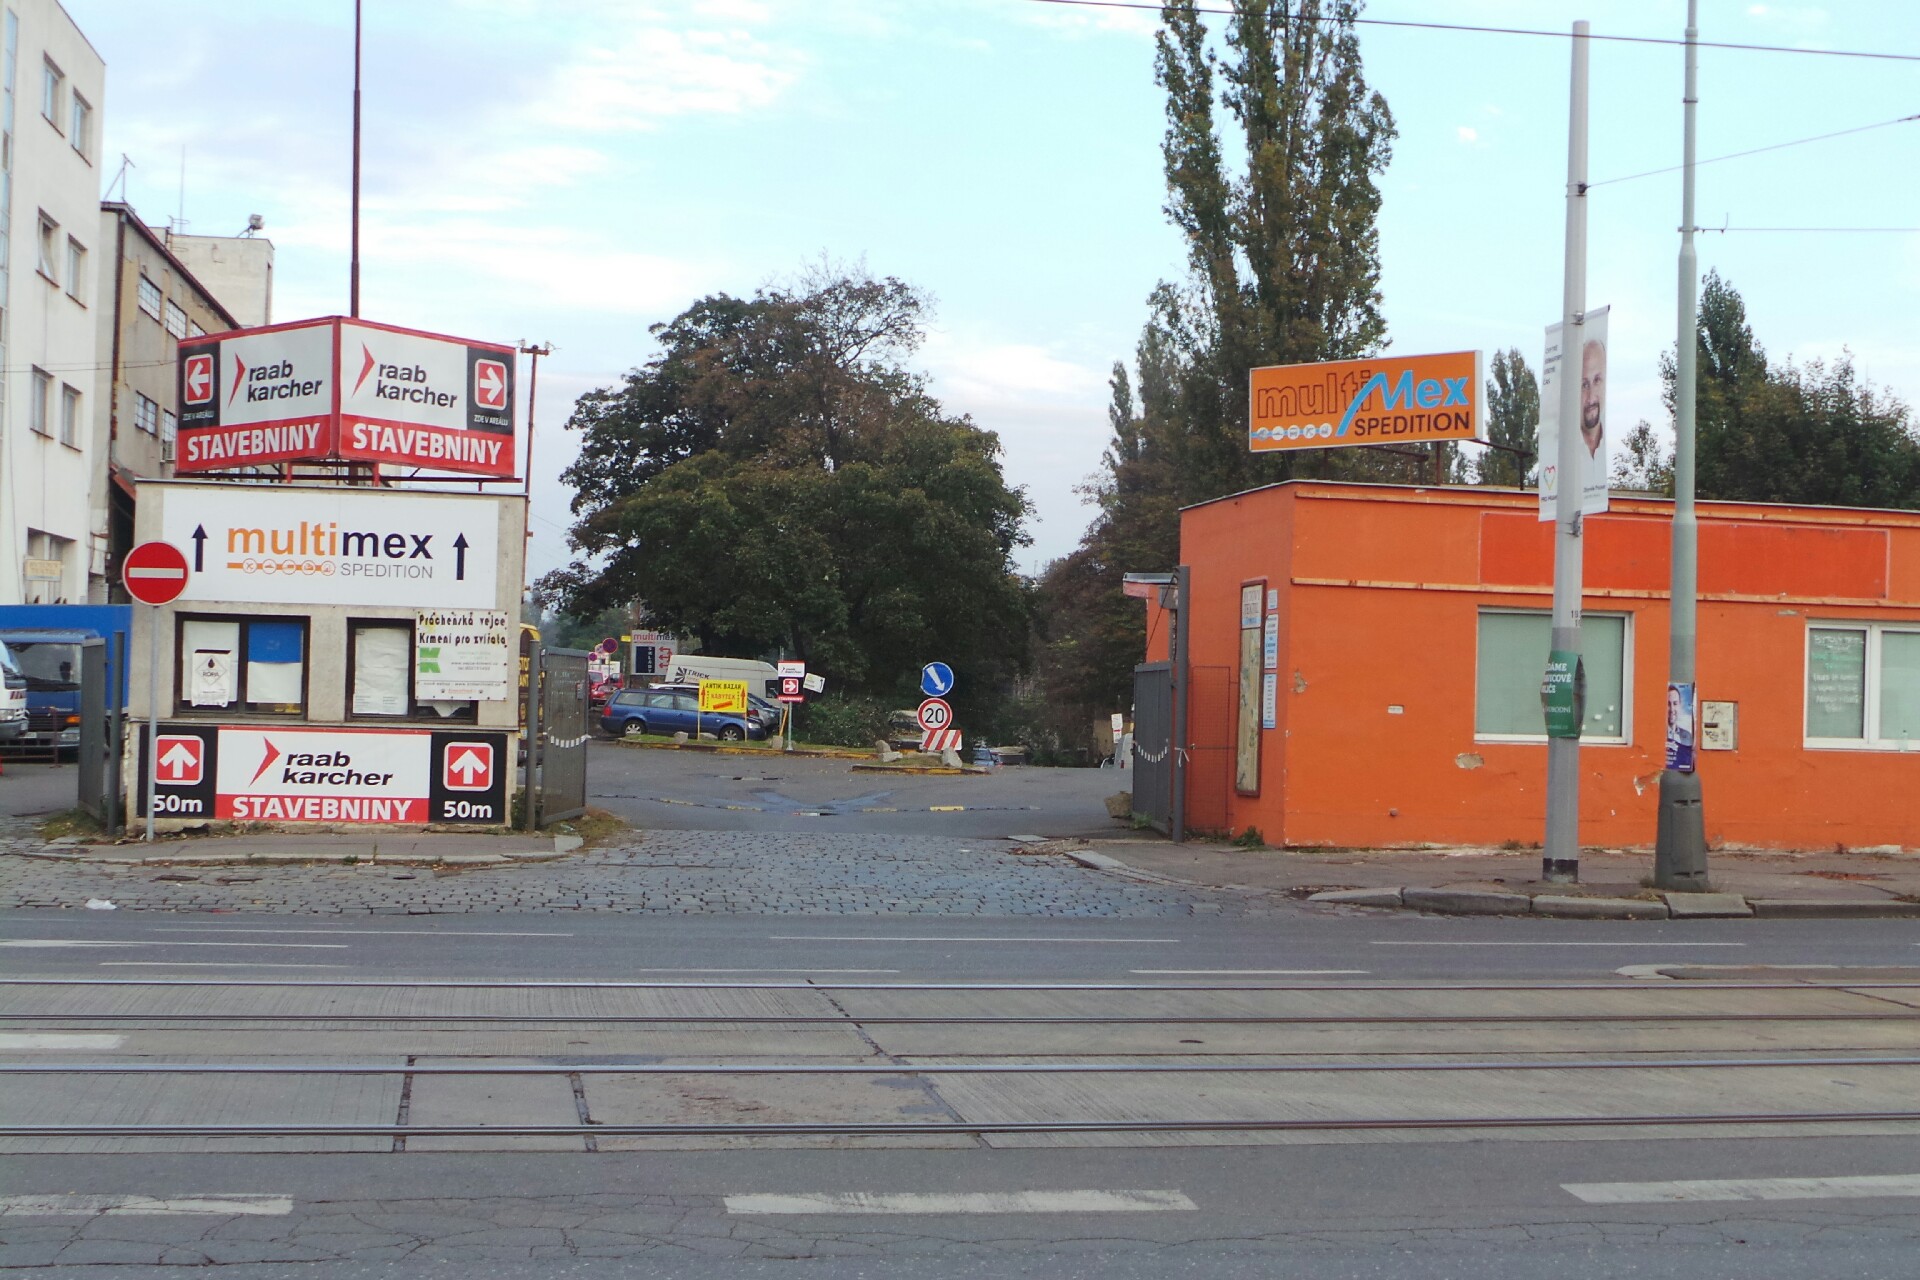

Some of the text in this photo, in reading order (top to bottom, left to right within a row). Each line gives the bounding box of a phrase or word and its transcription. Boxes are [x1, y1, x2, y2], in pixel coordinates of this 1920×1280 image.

[249, 360, 294, 382] raab
[378, 361, 427, 383] raab
[248, 378, 322, 403] karcher
[376, 380, 457, 409] karcher
[1354, 411, 1470, 437] SPEDITION
[187, 423, 320, 462] STAVEBNINY
[352, 423, 503, 466] STAVEBNINY
[227, 521, 434, 560] multimex
[340, 562, 433, 580] SPEDITION
[480, 614, 506, 629] vejce
[455, 635, 470, 646] pro
[925, 708, 944, 723] 20
[286, 751, 351, 768] raab
[282, 768, 393, 787] karcher
[153, 794, 203, 813] 50m
[232, 797, 412, 821] STAVEBNINY
[443, 800, 492, 819] 50m
